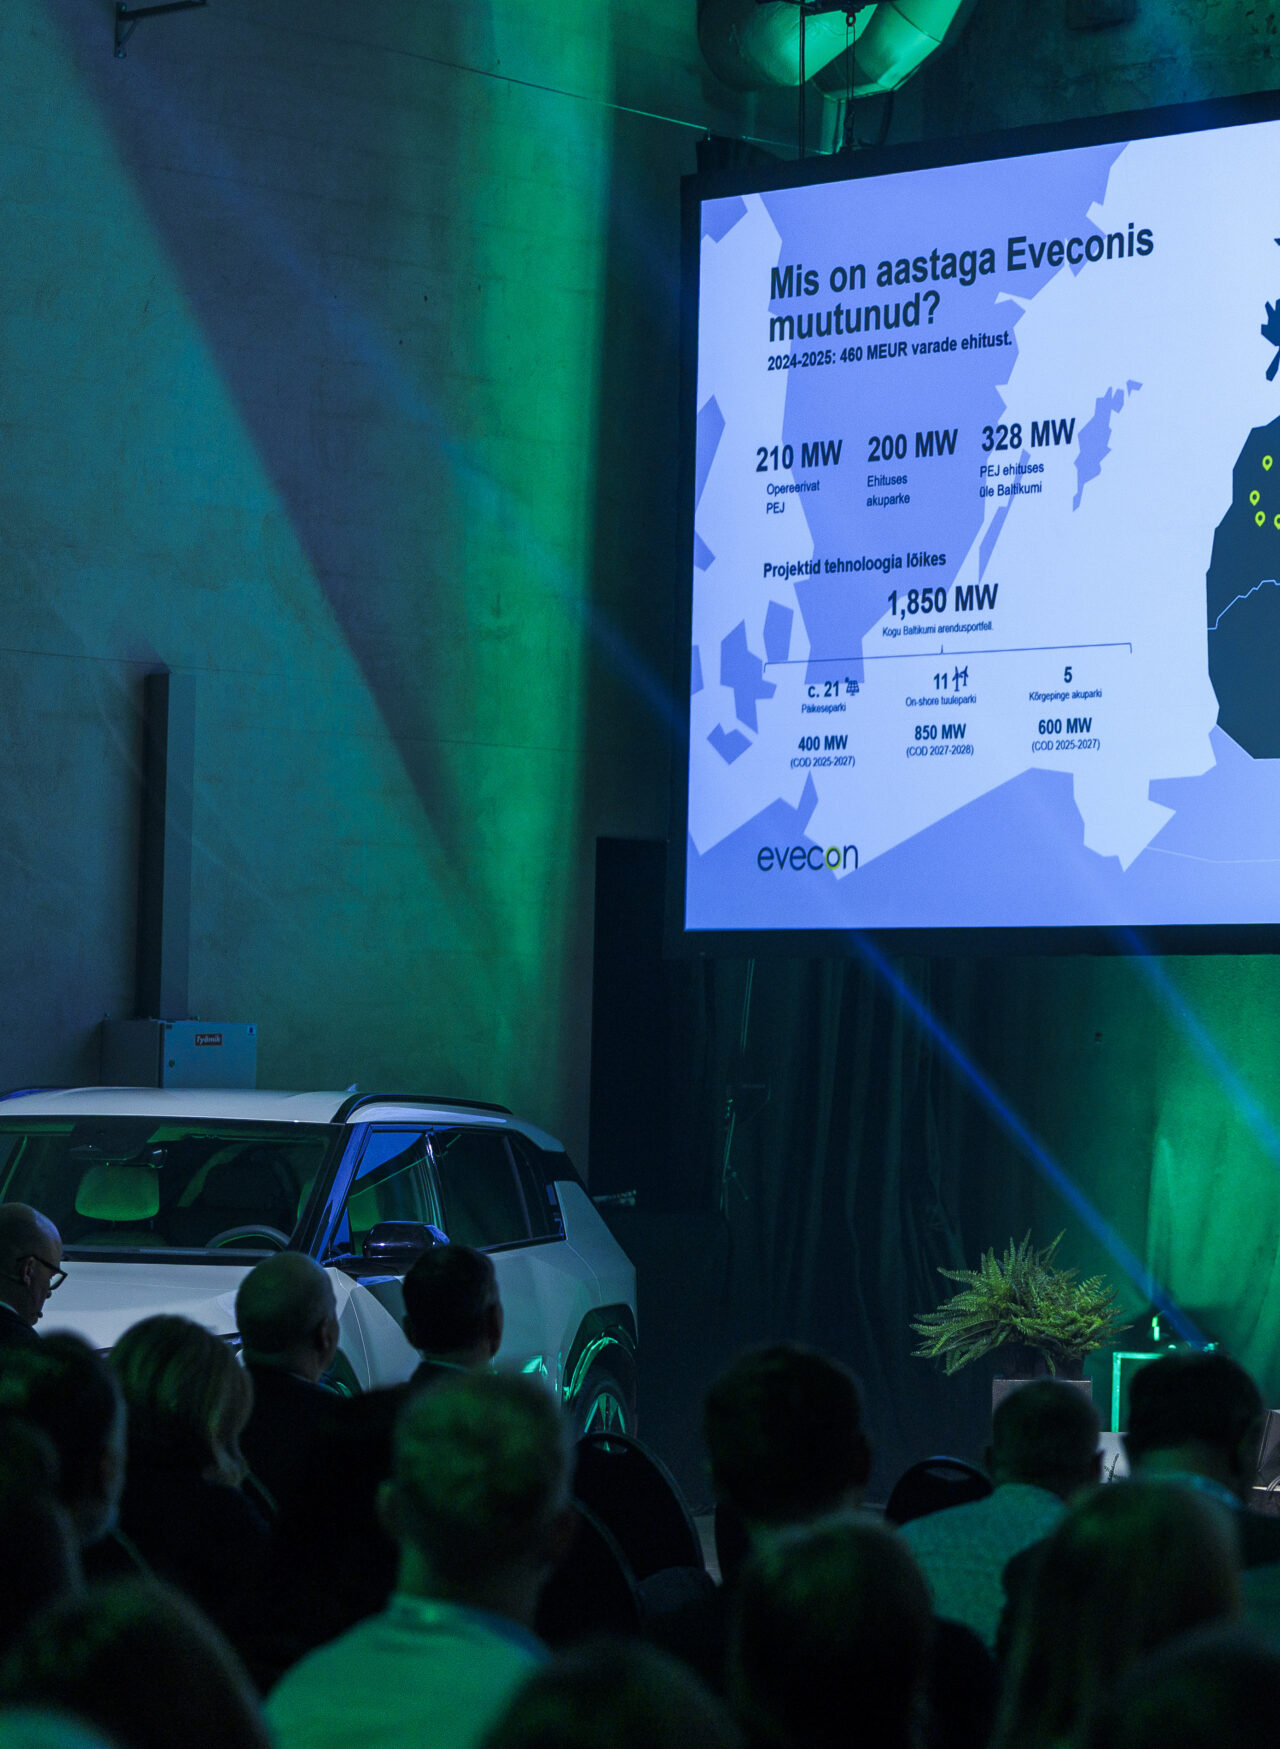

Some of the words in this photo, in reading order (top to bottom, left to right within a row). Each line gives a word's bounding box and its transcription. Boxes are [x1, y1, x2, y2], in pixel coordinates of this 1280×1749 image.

[770, 263, 820, 300] Mis
[829, 263, 866, 293] on
[876, 248, 996, 288] aastaga
[1007, 222, 1154, 272] Eveconis
[769, 289, 942, 344] muutunud?
[767, 349, 836, 371] 2024-2025:
[839, 346, 863, 363] 460
[866, 341, 908, 361] MEUR
[911, 336, 958, 356] varade
[960, 330, 1012, 350] ehitust.
[981, 423, 1023, 452] 328
[1030, 417, 1076, 448] MW
[867, 433, 908, 463] 200
[915, 428, 959, 458] MW
[756, 444, 794, 473] 210
[801, 439, 843, 468] MW
[979, 464, 1000, 478] PEJ
[1002, 462, 1045, 476] ehituses
[766, 479, 820, 497] Opereerivat
[867, 474, 908, 488] Ehituses
[979, 485, 995, 498] üle
[997, 482, 1043, 497] Baltikumi
[766, 501, 785, 514] PEJ
[866, 492, 911, 508] akuparke
[763, 559, 821, 581] Projektid
[824, 553, 903, 574] tehnoloogia
[906, 551, 947, 569] lõikes
[887, 586, 947, 621] 1,850
[954, 583, 999, 612] MW
[882, 626, 902, 639] Kogu
[902, 625, 936, 636] Baltikumi
[933, 672, 948, 690] 11
[1063, 666, 1073, 684] 5
[807, 685, 820, 699] c.
[823, 680, 840, 698] 21
[1029, 691, 1070, 703] Kõrgepinge
[1071, 689, 1103, 701] akuparki
[905, 696, 940, 707] On-shore
[941, 694, 977, 706] tuuleparki
[914, 724, 938, 741] 850
[941, 723, 967, 740] MW
[1038, 718, 1062, 735] 600
[1066, 717, 1092, 734] MW
[798, 736, 821, 752] 400
[824, 735, 848, 751] MW
[906, 746, 928, 757] (COD
[929, 744, 975, 757] 2027-2028)
[1031, 740, 1054, 753] (COD
[1055, 738, 1101, 751] 2025-2027)
[790, 757, 812, 769] (COD
[812, 755, 856, 767] 2025-2027)
[756, 845, 859, 872] evecon
